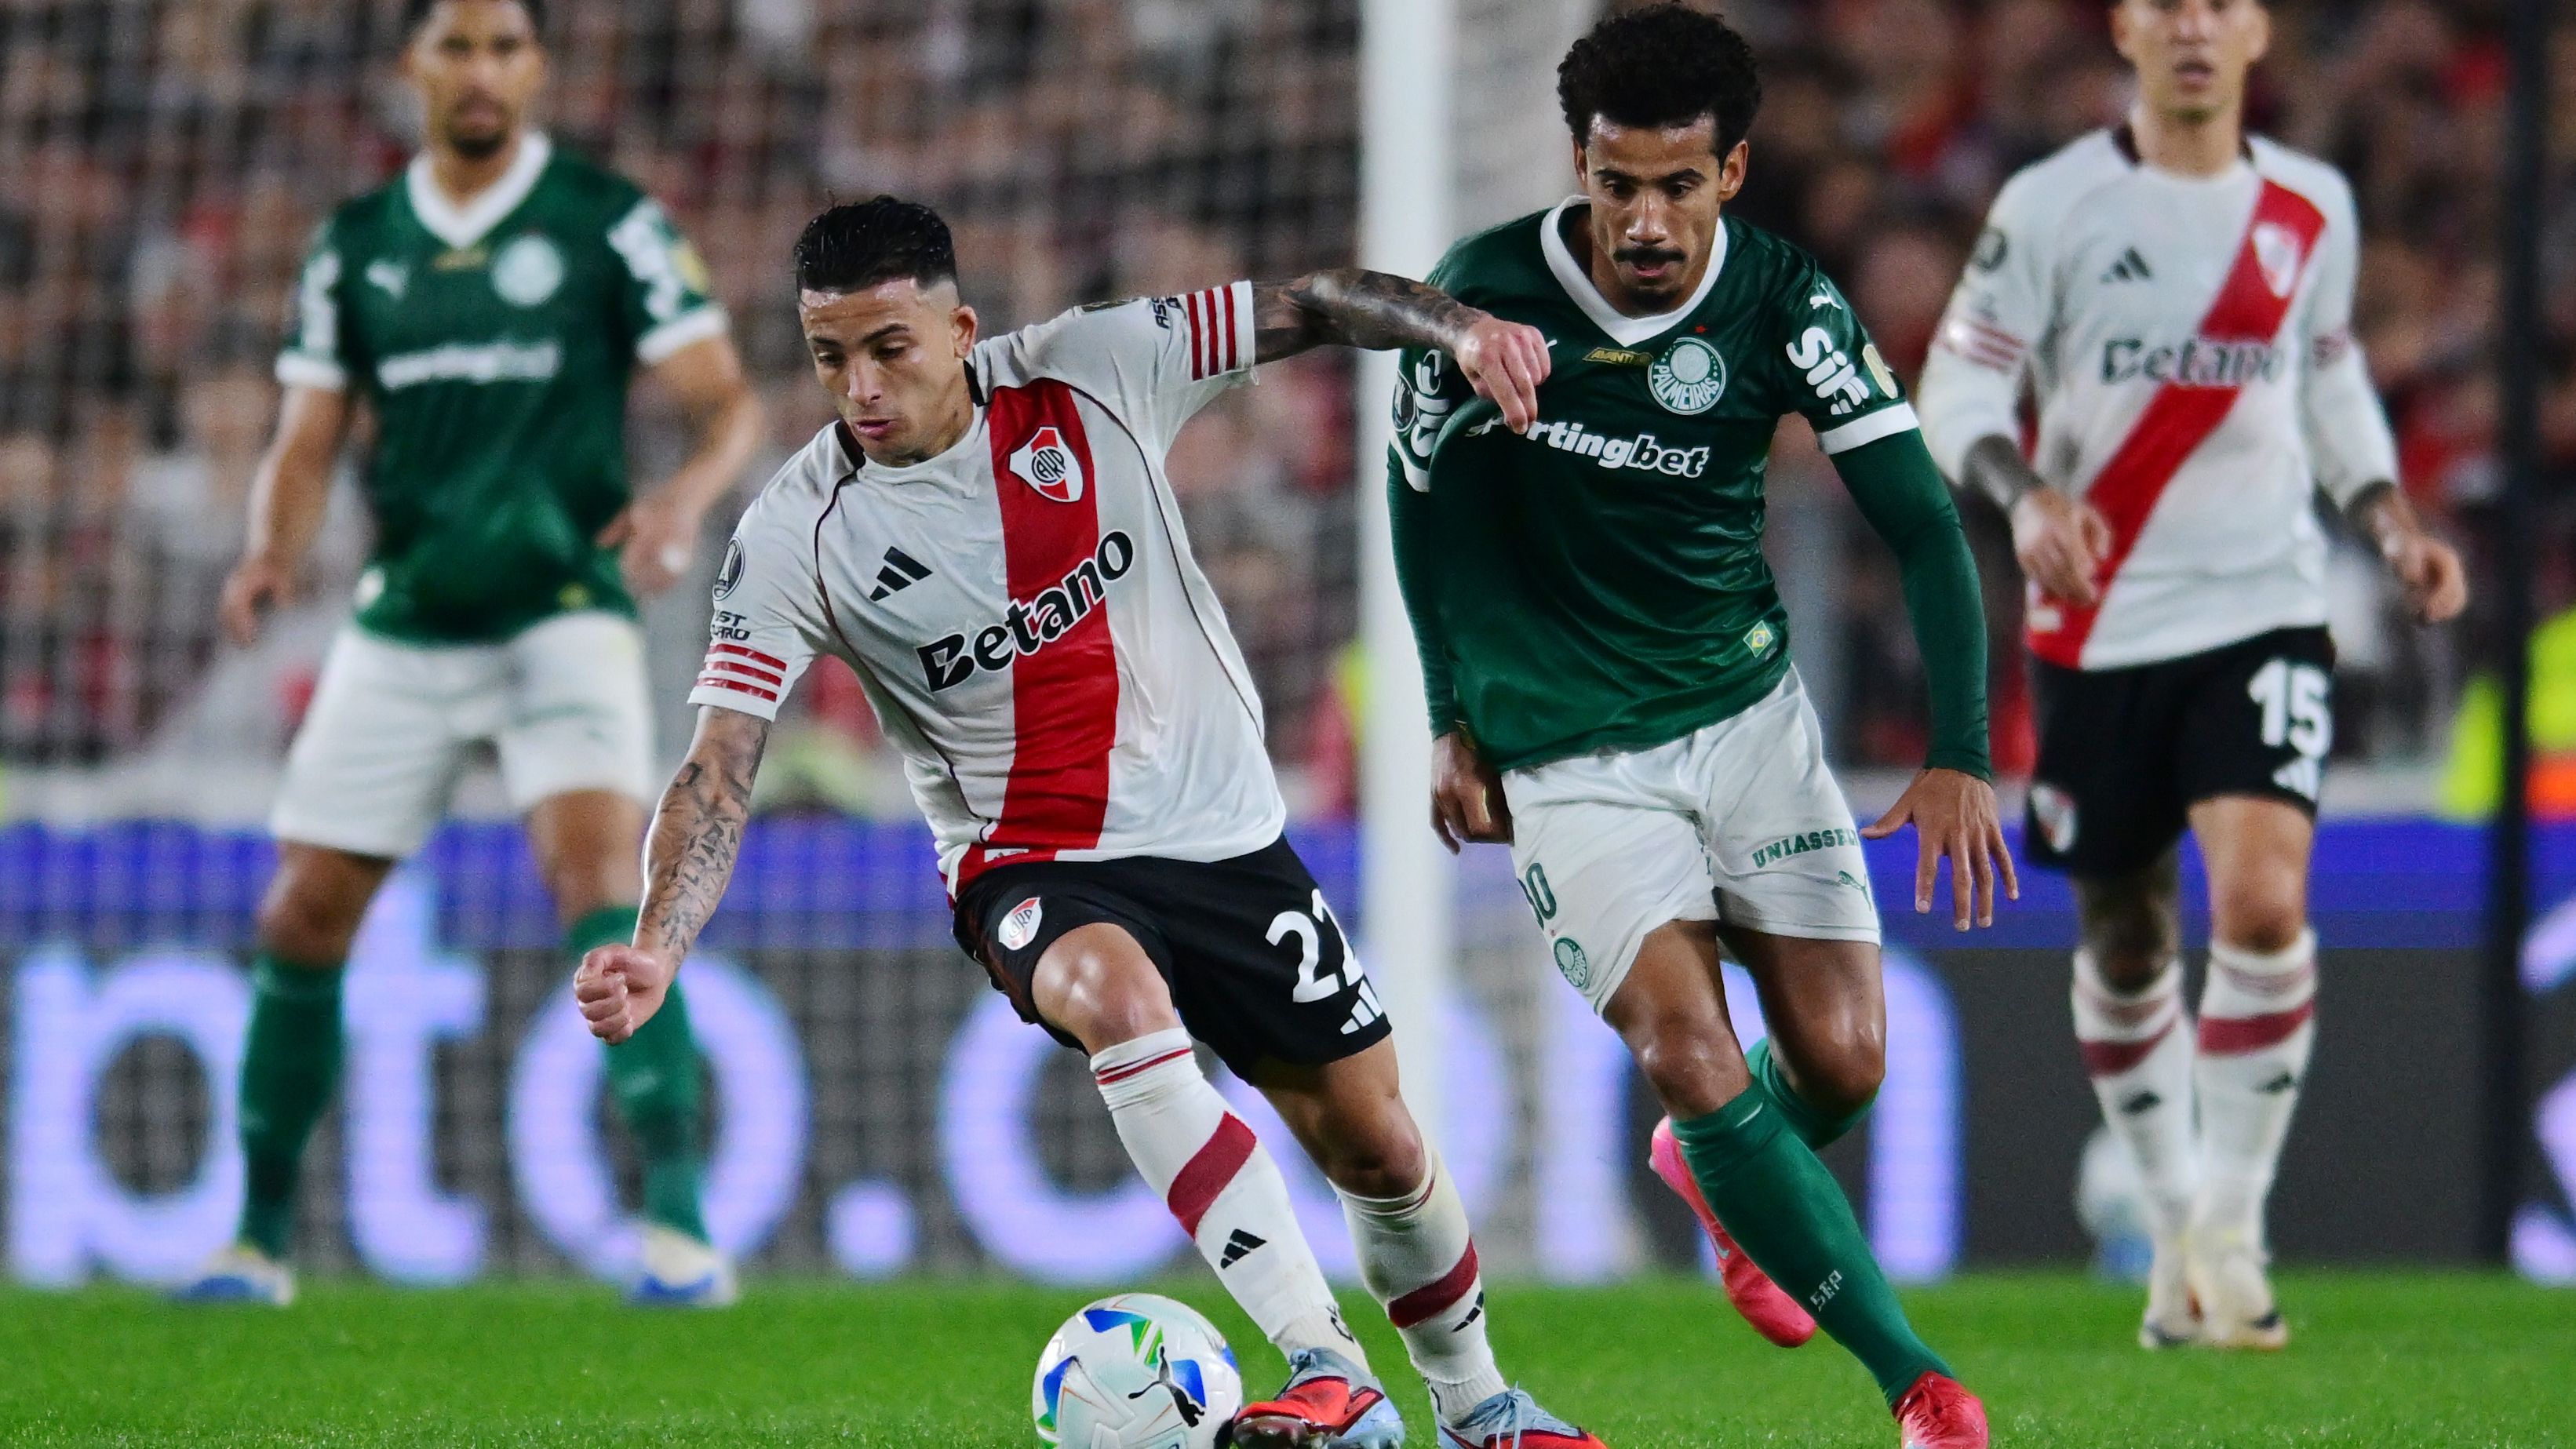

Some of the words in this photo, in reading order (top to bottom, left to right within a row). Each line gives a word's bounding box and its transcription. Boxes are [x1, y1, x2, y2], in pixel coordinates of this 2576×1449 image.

[1652, 365, 1720, 410] PALMEIRAS
[1464, 417, 1711, 479] rtingbet
[915, 530, 1134, 693] Betano
[2247, 657, 2332, 758] 15
[1809, 1269, 1842, 1312] SEP
